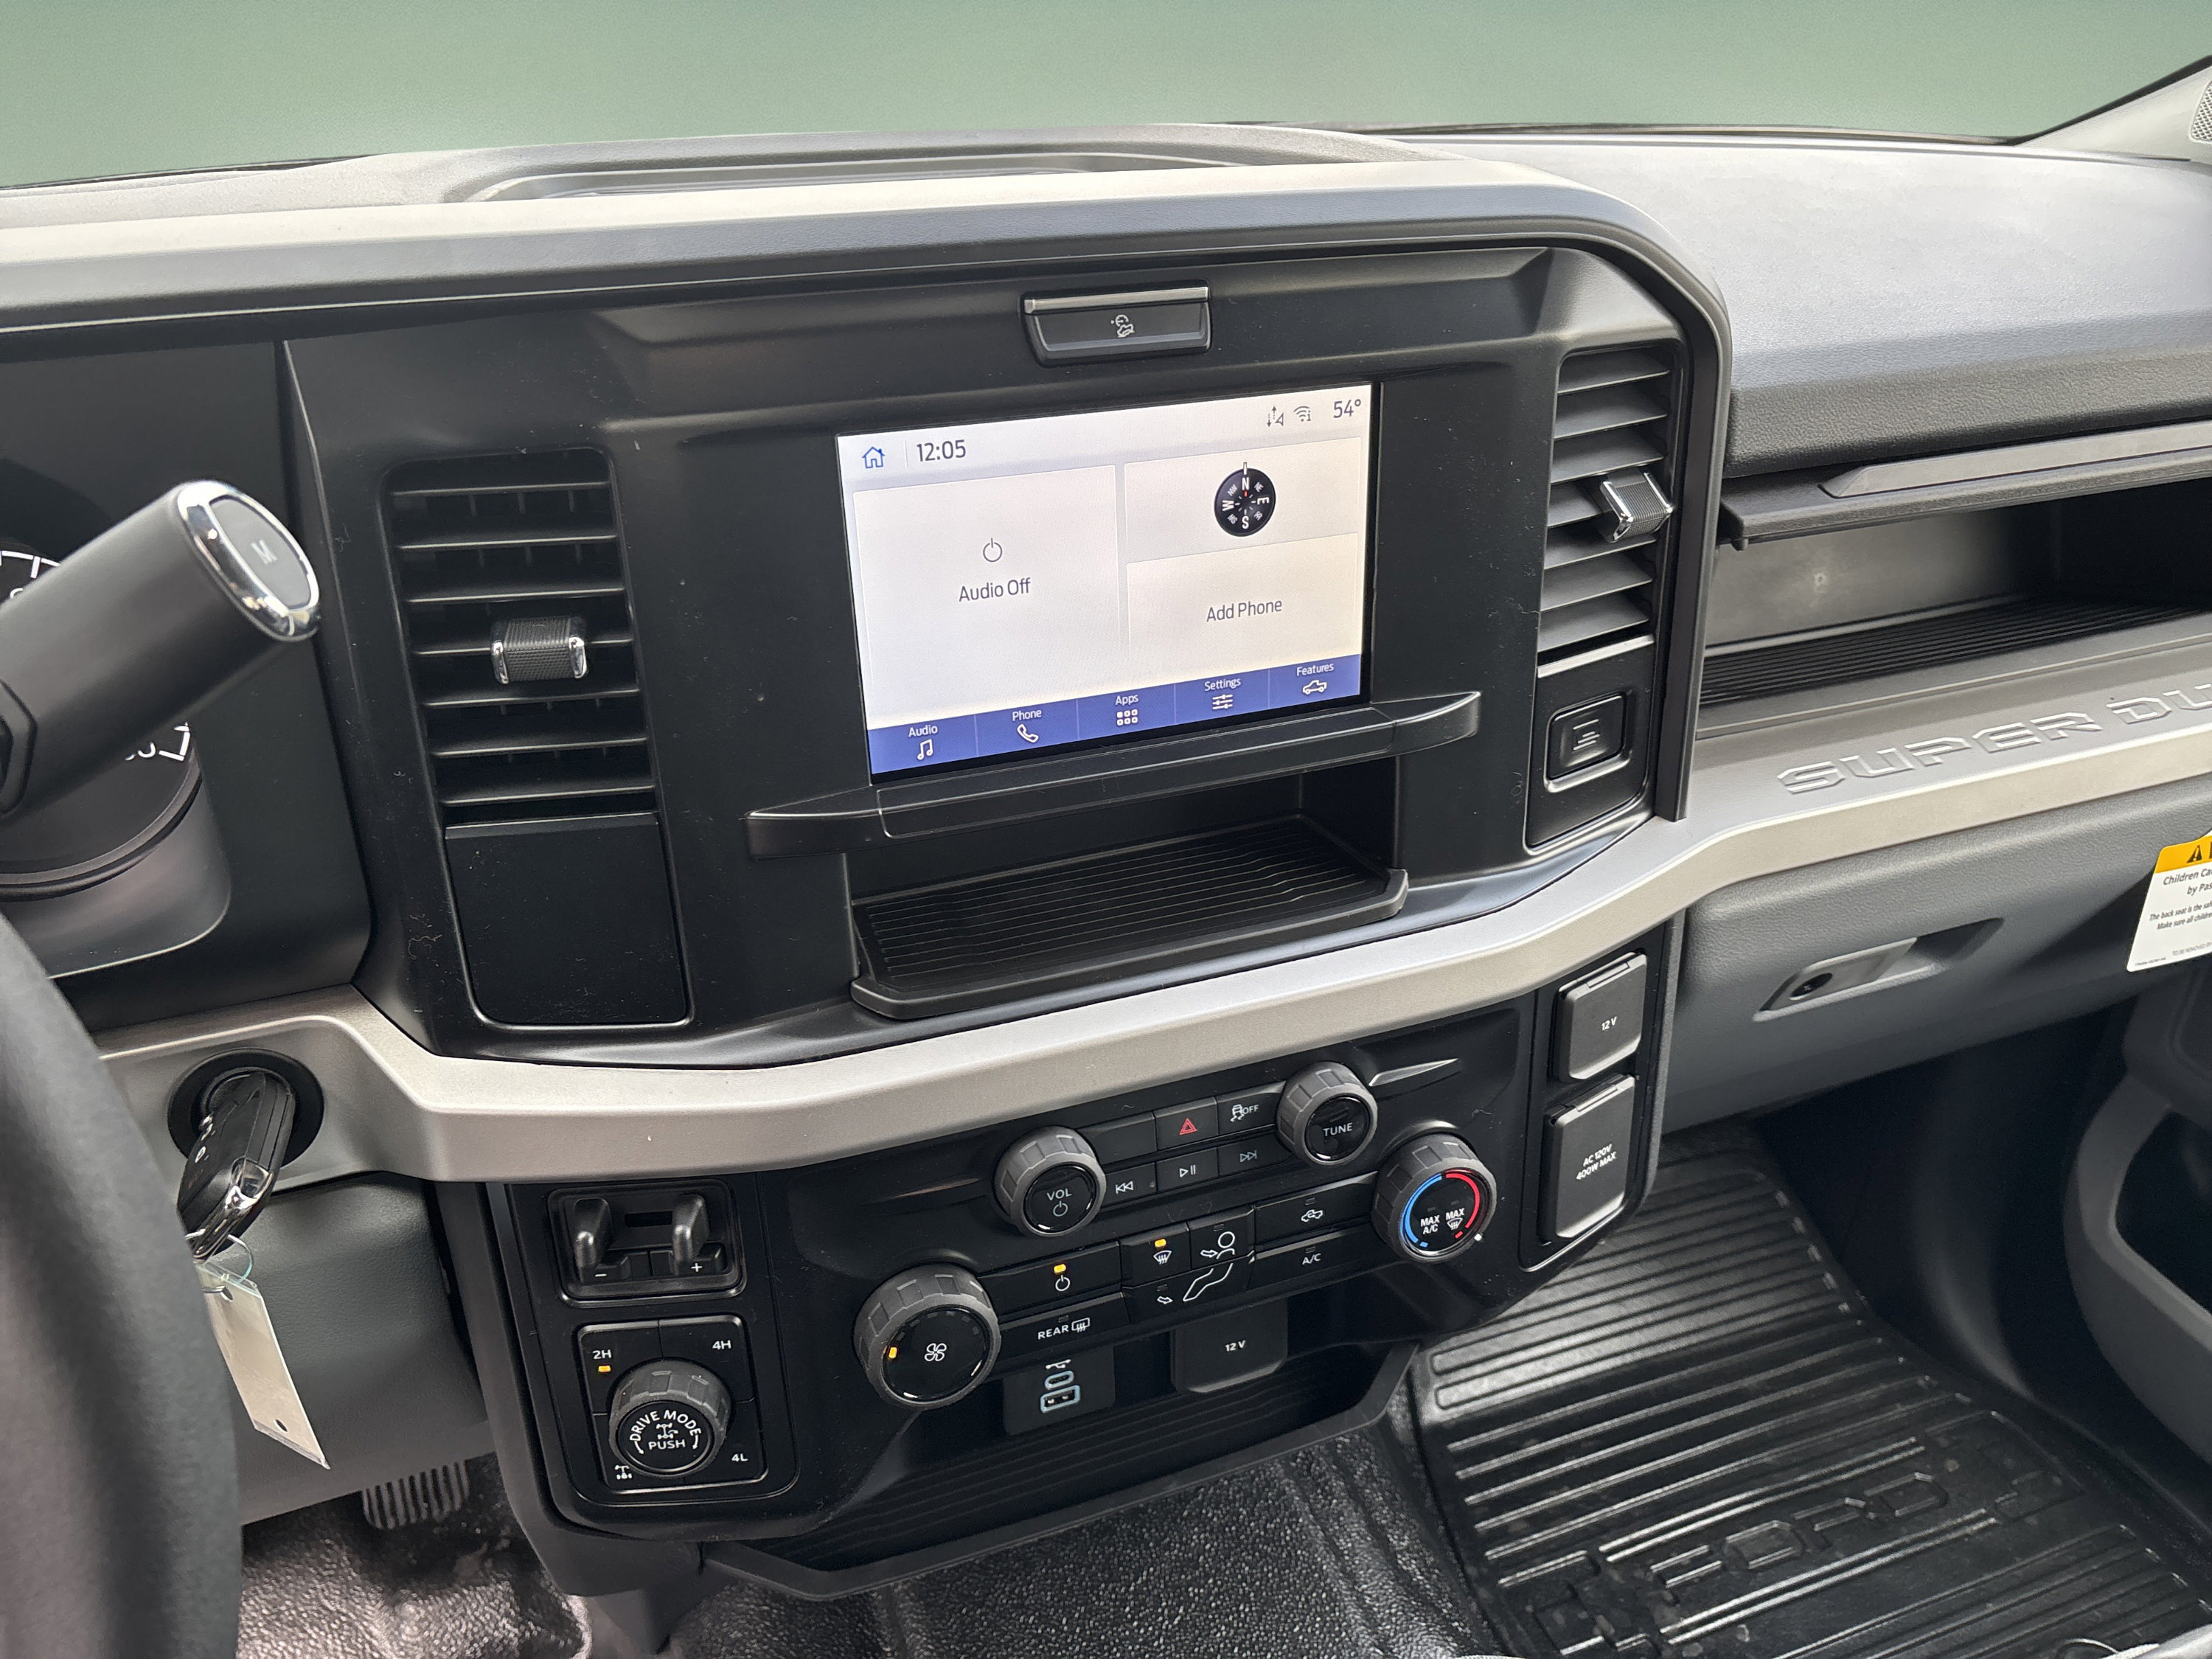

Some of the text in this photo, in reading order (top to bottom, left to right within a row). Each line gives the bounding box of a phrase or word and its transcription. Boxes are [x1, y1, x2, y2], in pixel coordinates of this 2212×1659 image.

[916, 439, 967, 462] 12:05
[1242, 476, 1251, 491] N
[1242, 515, 1250, 529] S
[959, 577, 1032, 602] Audio Off
[1206, 599, 1283, 622] Add Phone
[1295, 662, 1335, 677] Features
[1203, 677, 1242, 692] Settings
[1115, 694, 1140, 706] Apps
[1012, 708, 1043, 722] Phone
[908, 723, 939, 738] Audio
[1777, 711, 2103, 794] SUPER
[2163, 868, 2212, 886] Children Ca
[2186, 886, 2198, 897] by
[1601, 1016, 1618, 1032] 12 V
[1242, 1105, 1259, 1115] OFF
[1322, 1122, 1354, 1137] TUNE
[1582, 1143, 1613, 1167] AC 120V
[1576, 1151, 1617, 1180] 400W MAX
[1046, 1187, 1073, 1201] VOL
[1420, 1214, 1440, 1228] MAX
[1445, 1207, 1465, 1221] MAX
[1422, 1223, 1439, 1235] A/C
[1301, 1253, 1322, 1265] A/C
[1037, 1324, 1069, 1340] REAR
[712, 1339, 732, 1351] 4H
[1224, 1339, 1246, 1352] 12 V
[592, 1349, 612, 1360] 2H
[629, 1409, 702, 1441] DRIVE MODE
[648, 1439, 686, 1450] PUSH
[731, 1453, 749, 1462] 4L
